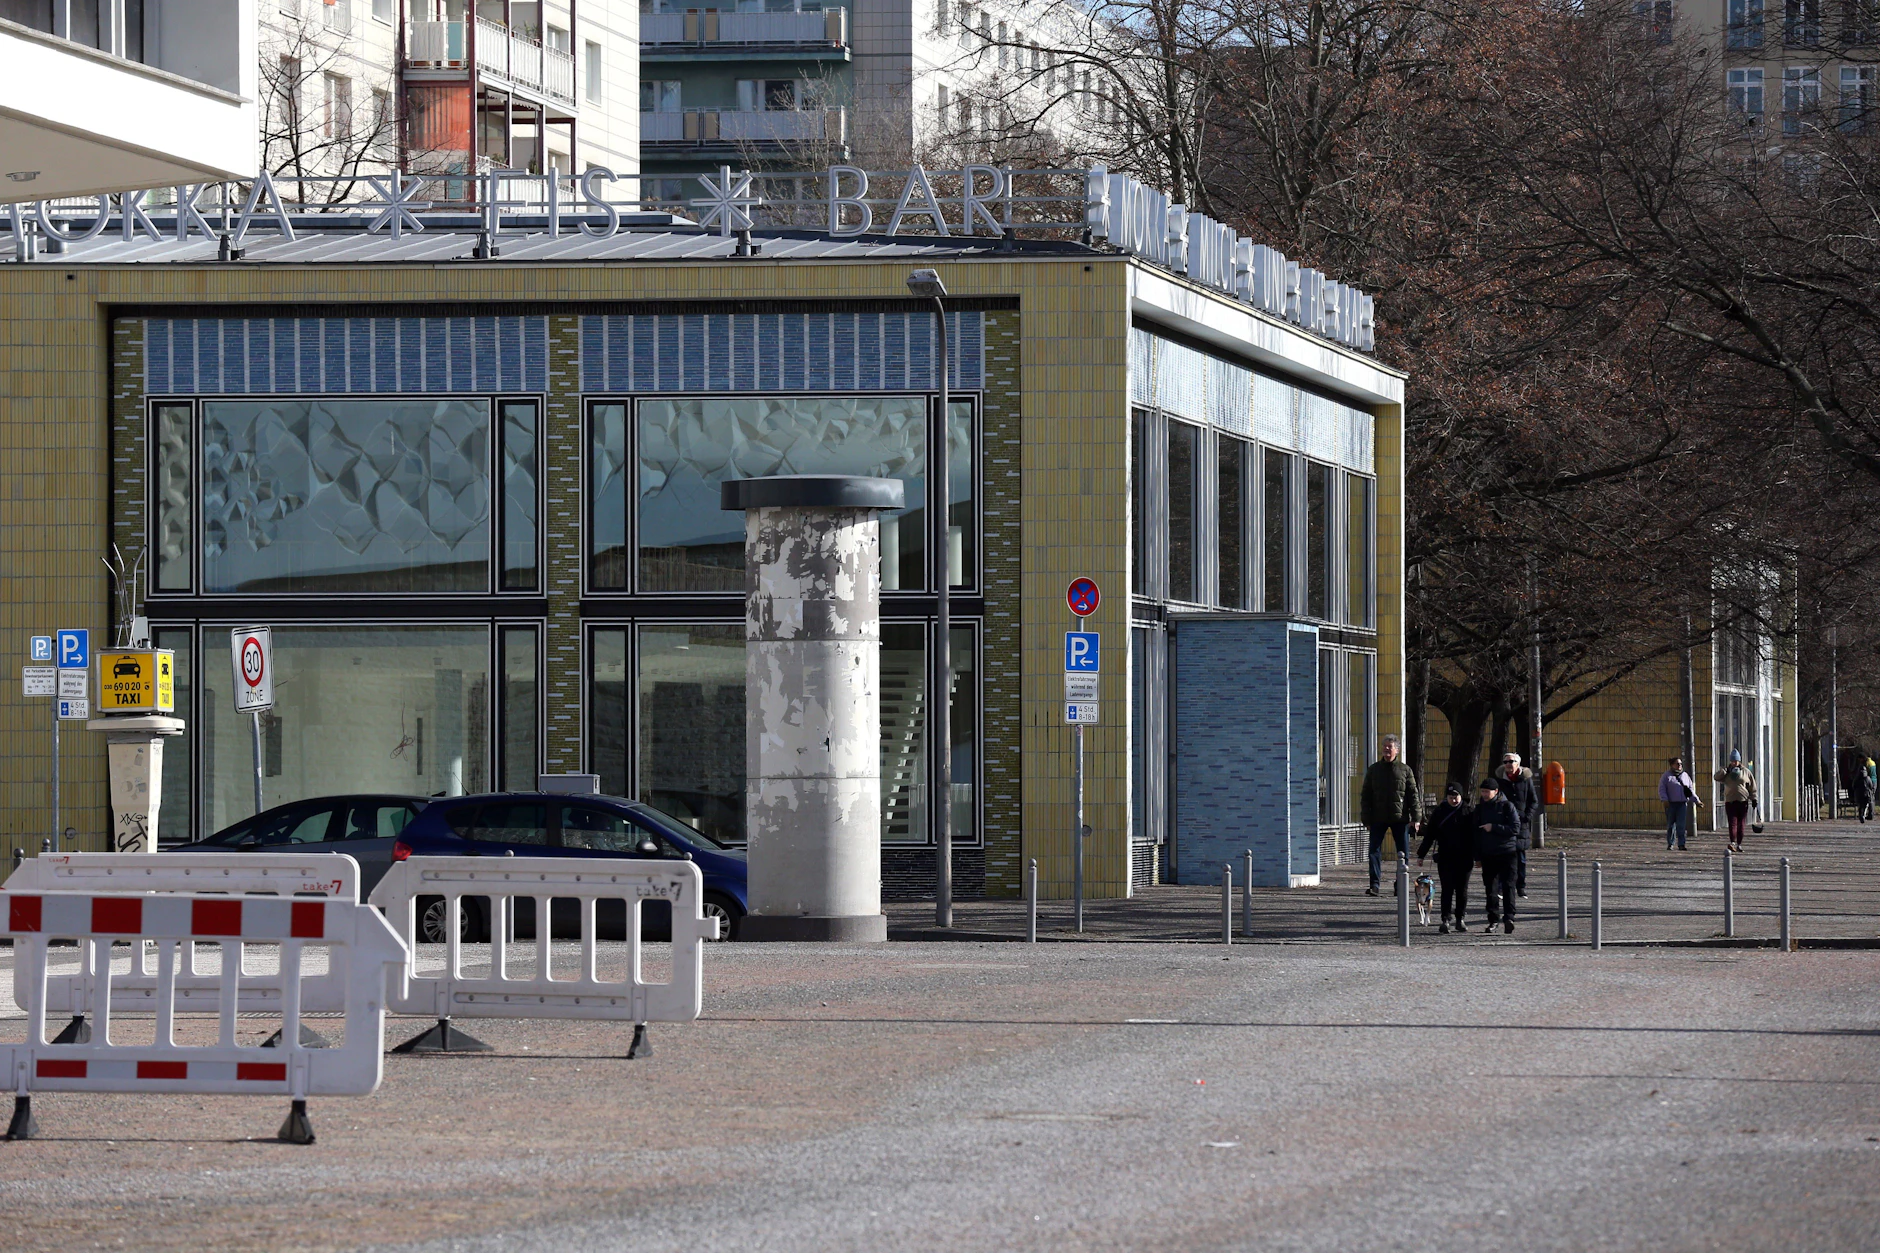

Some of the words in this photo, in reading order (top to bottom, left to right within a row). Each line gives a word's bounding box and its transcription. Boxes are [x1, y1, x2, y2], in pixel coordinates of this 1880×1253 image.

[490, 166, 620, 240] EIS
[829, 164, 1006, 238] BAR
[36, 639, 46, 657] P
[63, 635, 79, 664] P
[1071, 637, 1089, 666] P
[246, 651, 259, 674] 30
[114, 693, 140, 704] TAXI
[246, 690, 264, 704] ZONE
